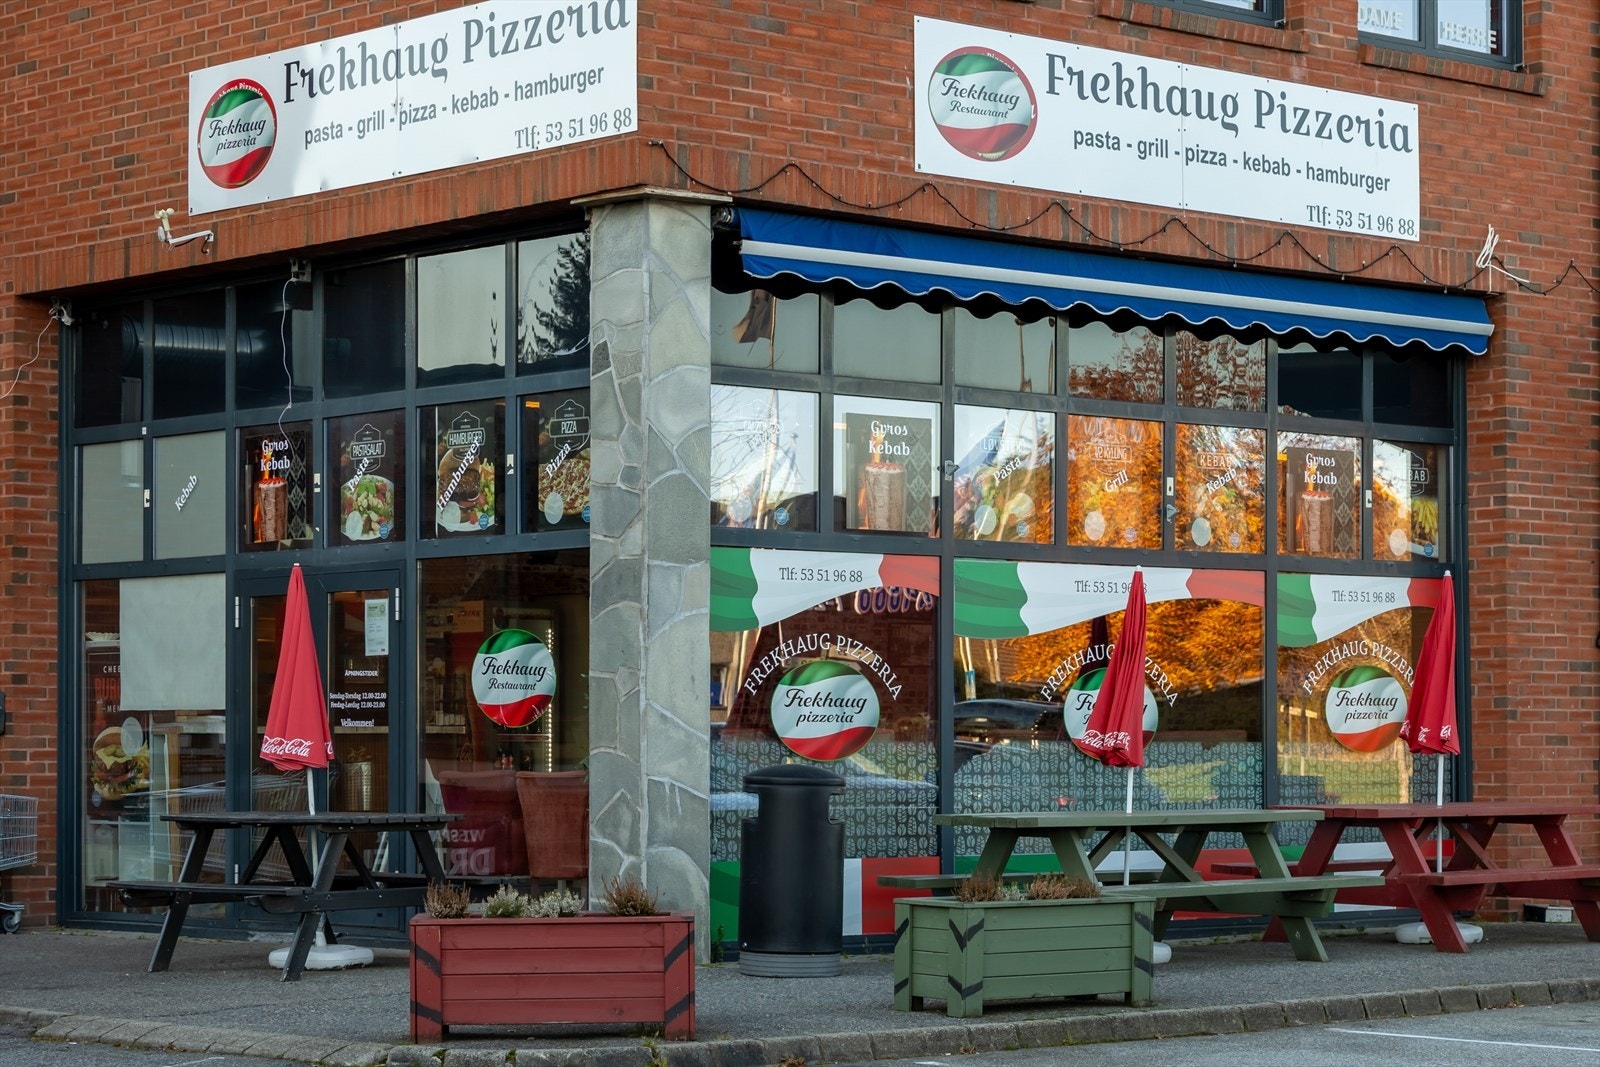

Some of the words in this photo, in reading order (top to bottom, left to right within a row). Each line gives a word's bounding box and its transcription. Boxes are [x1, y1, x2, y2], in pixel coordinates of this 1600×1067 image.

[1443, 20, 1497, 49] HERRE
[284, 32, 448, 104] Frekhaug
[463, 0, 631, 64] Pizzeria
[941, 77, 1020, 111] Frekhaug
[1045, 53, 1239, 138] Frekhaug
[1253, 88, 1413, 154] Pizzeria
[304, 120, 343, 149] pasta
[357, 110, 385, 140] grill
[399, 103, 437, 131] pizza
[451, 86, 499, 114] kebab
[514, 65, 604, 102] hamburger
[949, 100, 1009, 119] Restaurant
[209, 118, 267, 138] Frekhaug
[514, 125, 540, 150] Tlf:
[545, 121, 563, 143] 53
[568, 117, 585, 138] 51
[590, 112, 608, 134] 96
[613, 107, 632, 129] 88
[216, 136, 257, 155] pizzeria
[1073, 129, 1121, 151] pasta
[1137, 137, 1168, 160] grill
[1185, 144, 1227, 167] pizza
[1243, 151, 1291, 177] kebab
[1306, 161, 1390, 194] hamburger
[1306, 204, 1331, 227] Tlf:
[1336, 209, 1353, 229] 53
[1357, 212, 1373, 231] 51
[1377, 214, 1394, 233] 96
[1398, 217, 1415, 236] 88
[449, 430, 483, 446] HAMBURGER
[561, 421, 577, 434] PIZZA
[871, 420, 908, 437] Gyros
[262, 439, 289, 455] Gyros
[352, 443, 383, 457] PASTASALAT
[868, 440, 910, 456] Kebab
[260, 456, 290, 471] Kebab
[544, 442, 571, 478] Pizza
[993, 457, 1022, 483] Pasta
[1305, 453, 1336, 469] Gyros
[347, 457, 369, 493] Pasta
[437, 436, 480, 511] Hamburger
[1104, 468, 1129, 494] Grill
[1205, 467, 1237, 494] Kebab
[1304, 471, 1338, 485] Kebab
[174, 474, 198, 512] Kebab
[779, 567, 798, 581] Tlf:
[800, 568, 814, 581] 53
[816, 569, 830, 581] 51
[833, 570, 847, 582] 96
[849, 570, 863, 582] 88
[1074, 580, 1091, 593] Tlf:
[1093, 581, 1105, 593] 53
[1107, 582, 1119, 593] 51
[1332, 590, 1346, 602] Tlf:
[1348, 591, 1359, 602] 53
[1360, 592, 1371, 603] 51
[1372, 592, 1383, 603] 96
[1385, 592, 1396, 603] 88
[481, 656, 547, 683] Frekhaug
[744, 633, 831, 696] FREKHAUG
[835, 634, 903, 701] PIZZERIA
[1302, 640, 1368, 696] FREKHAUG
[488, 677, 537, 691] Restaurant
[784, 688, 868, 714] Frekhaug
[1335, 689, 1399, 711] Frekhaug
[340, 718, 375, 728] Velkommen!
[796, 712, 854, 727] pizzeria
[1344, 709, 1389, 723] pizzeria
